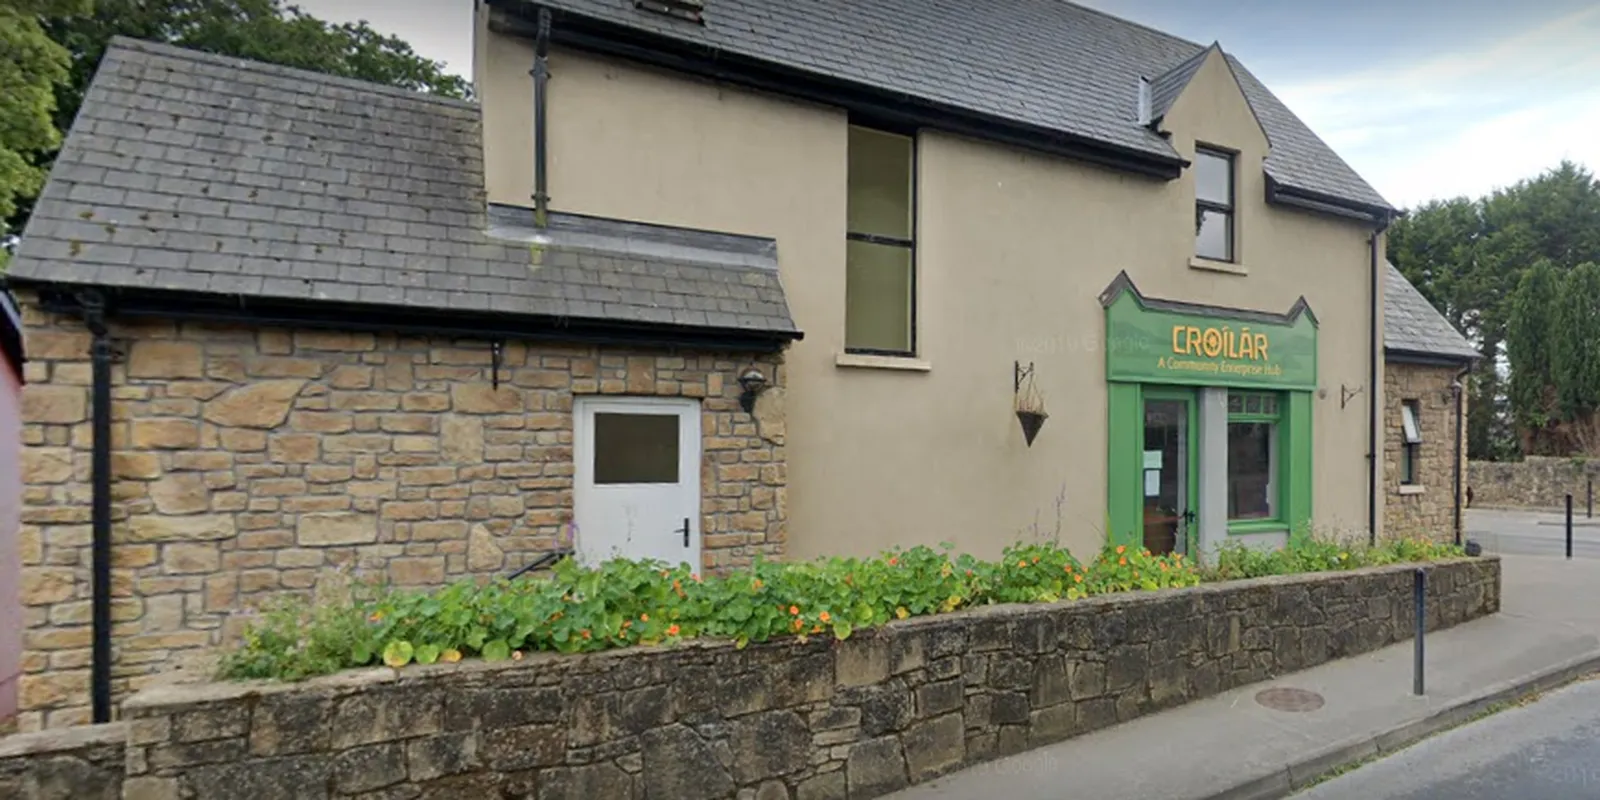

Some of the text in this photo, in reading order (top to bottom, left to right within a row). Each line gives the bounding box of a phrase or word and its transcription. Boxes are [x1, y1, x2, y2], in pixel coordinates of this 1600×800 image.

[1157, 357, 1165, 368] A
[1167, 357, 1219, 374] Community
[1264, 364, 1282, 376] Hub
